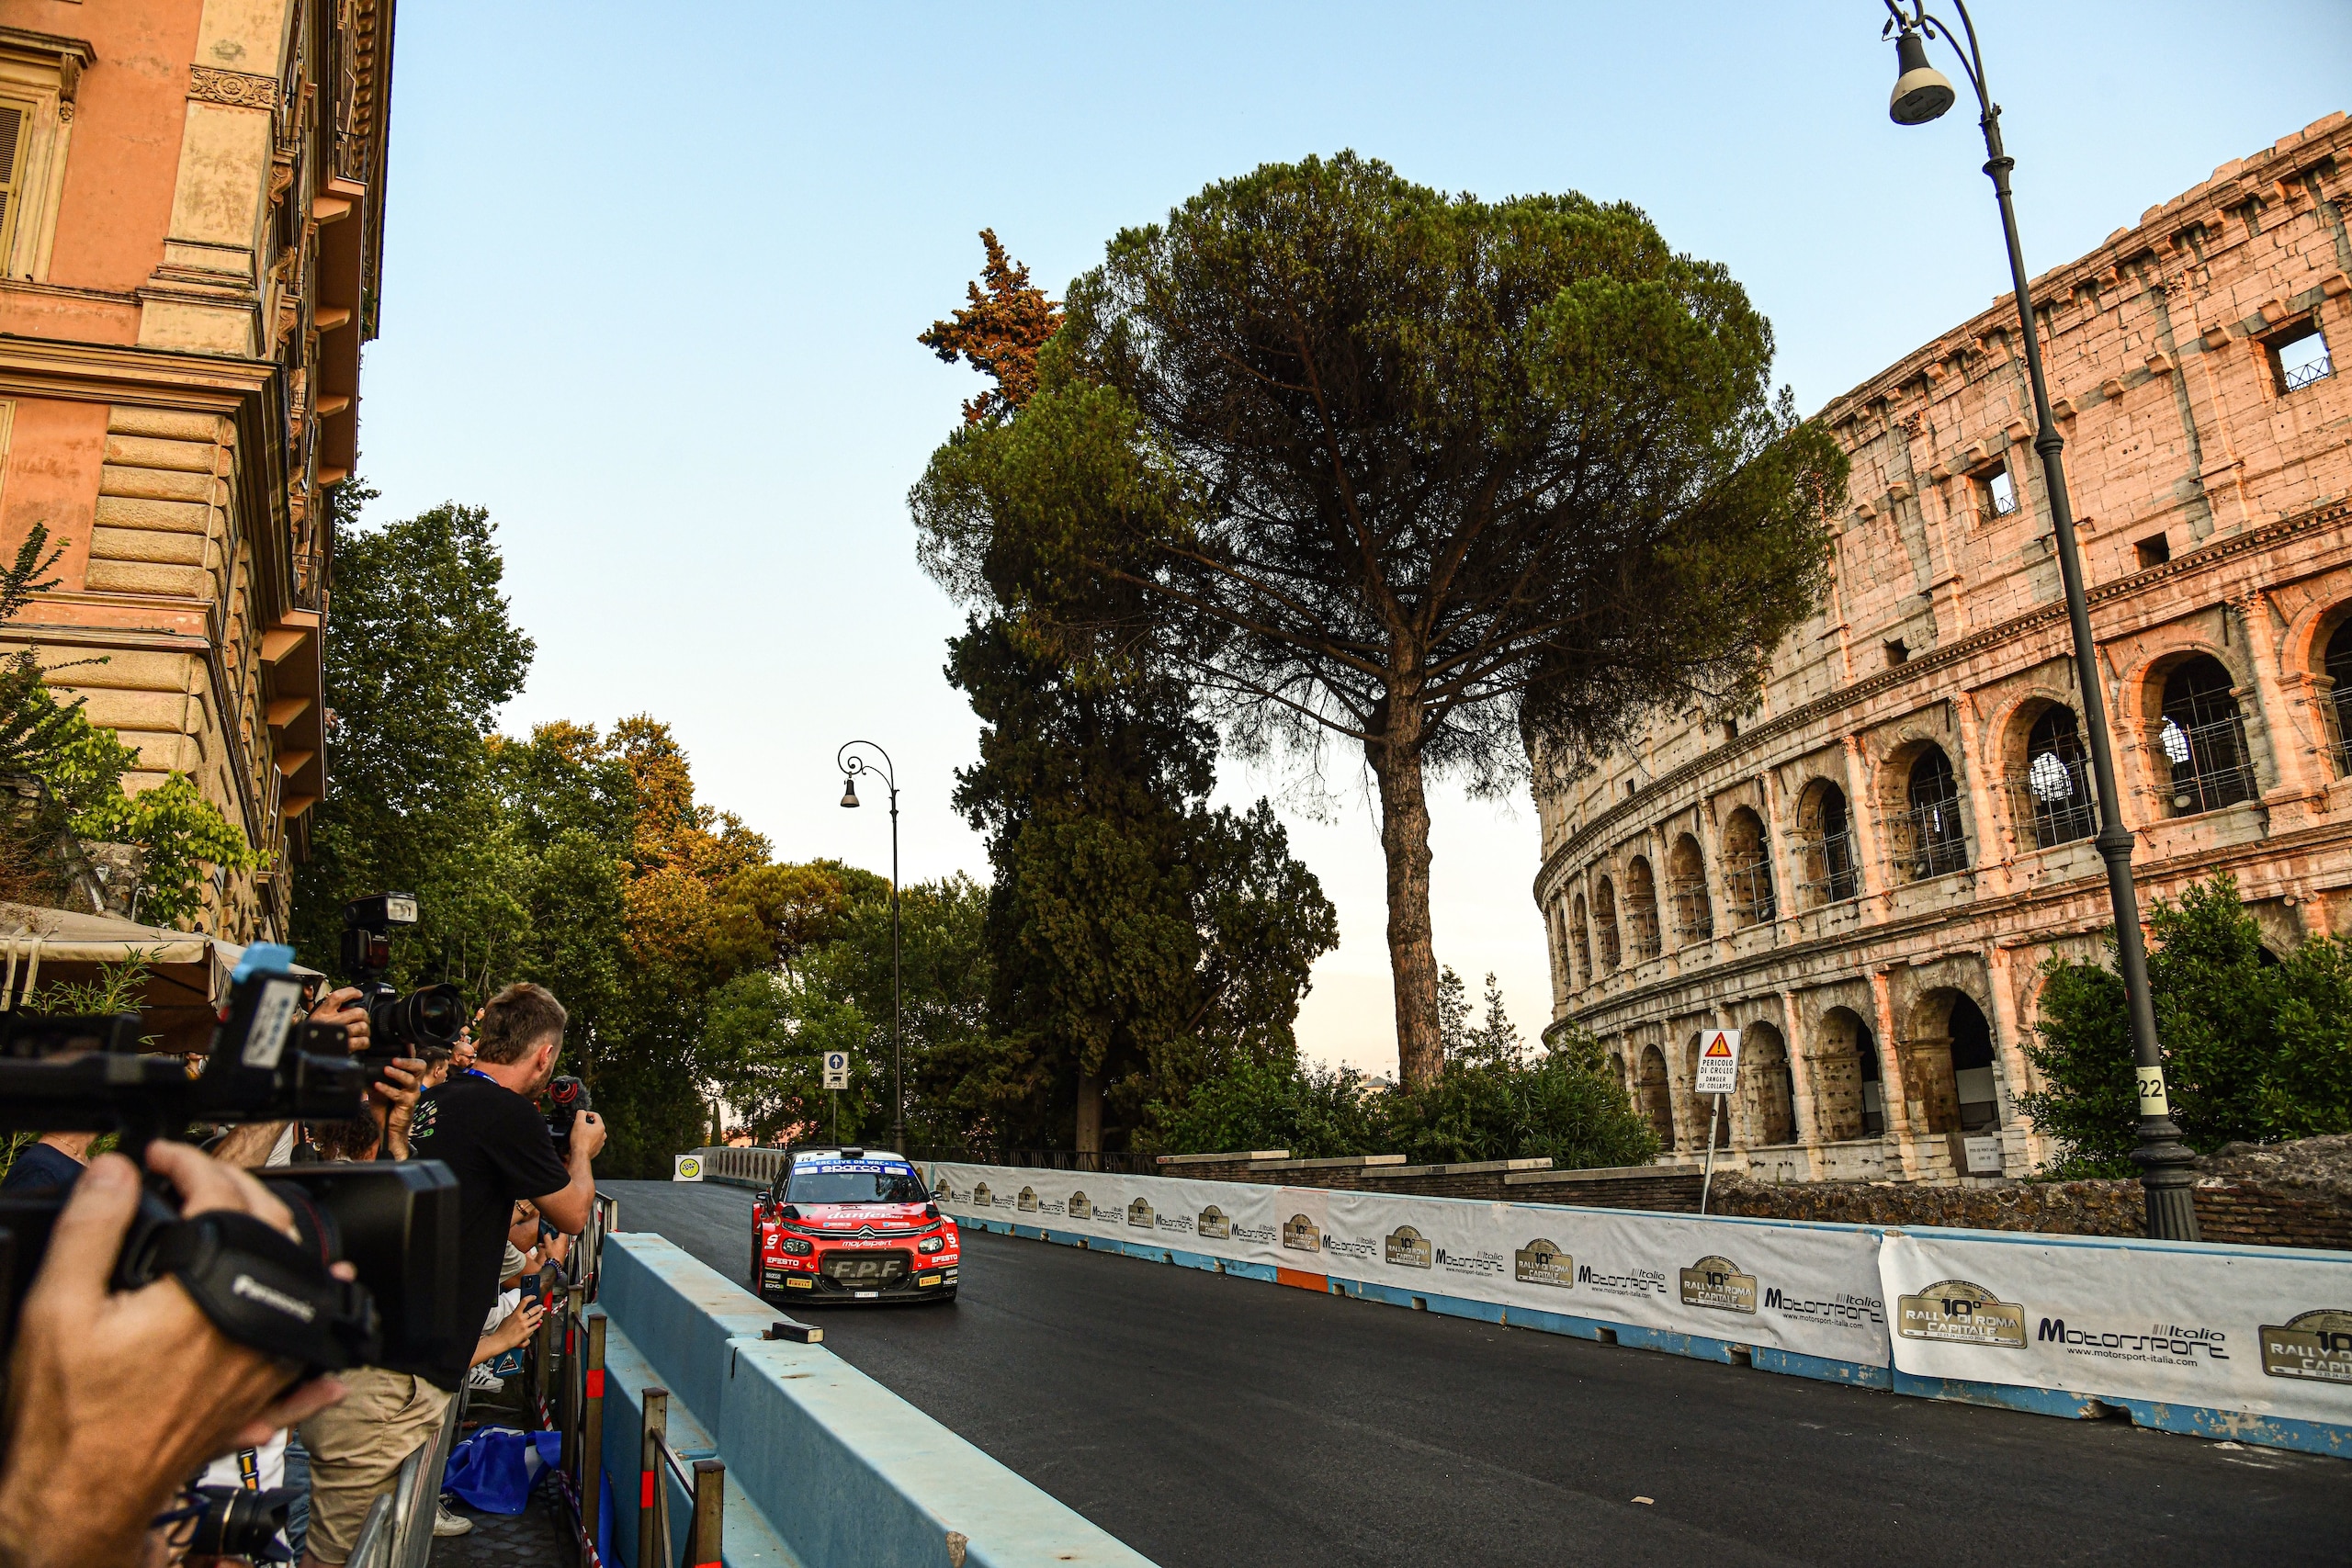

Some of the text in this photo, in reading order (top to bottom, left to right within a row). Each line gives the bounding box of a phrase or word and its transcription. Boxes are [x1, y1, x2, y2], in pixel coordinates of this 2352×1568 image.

[2139, 1079, 2163, 1098] 22
[766, 1257, 799, 1266] EFESTO
[932, 1254, 958, 1263] EFESTO
[1435, 1248, 1505, 1272] Motorsport
[1518, 1260, 1540, 1269] RALLY
[1549, 1264, 1569, 1272] ROMA
[1535, 1252, 1553, 1265] 10°
[833, 1260, 902, 1278] F.P.F.
[1529, 1269, 1559, 1280] CAPITALE
[1639, 1269, 1666, 1280] Italia
[1578, 1265, 1668, 1293] Motorsport
[1705, 1270, 1729, 1286] 10°
[1591, 1286, 1652, 1299] www.motorsport-italia.com
[1684, 1280, 1713, 1291] RALLY
[1725, 1285, 1752, 1297] ROMA
[1698, 1291, 1738, 1303] CAPITALE
[1846, 1294, 1882, 1308] Italia
[1764, 1287, 1883, 1324] Motorsport
[1940, 1298, 1982, 1317] 10°
[1782, 1313, 1864, 1330] www.motorsport-italia.com
[1905, 1309, 2019, 1329] RALLY DI ROMA
[1928, 1322, 1997, 1337] CAPITALE
[2168, 1325, 2225, 1341] Italia
[2038, 1317, 2230, 1360] Motorsport
[2066, 1347, 2198, 1368] www.motorsport-italia.com
[2270, 1342, 2332, 1359] RALLY
